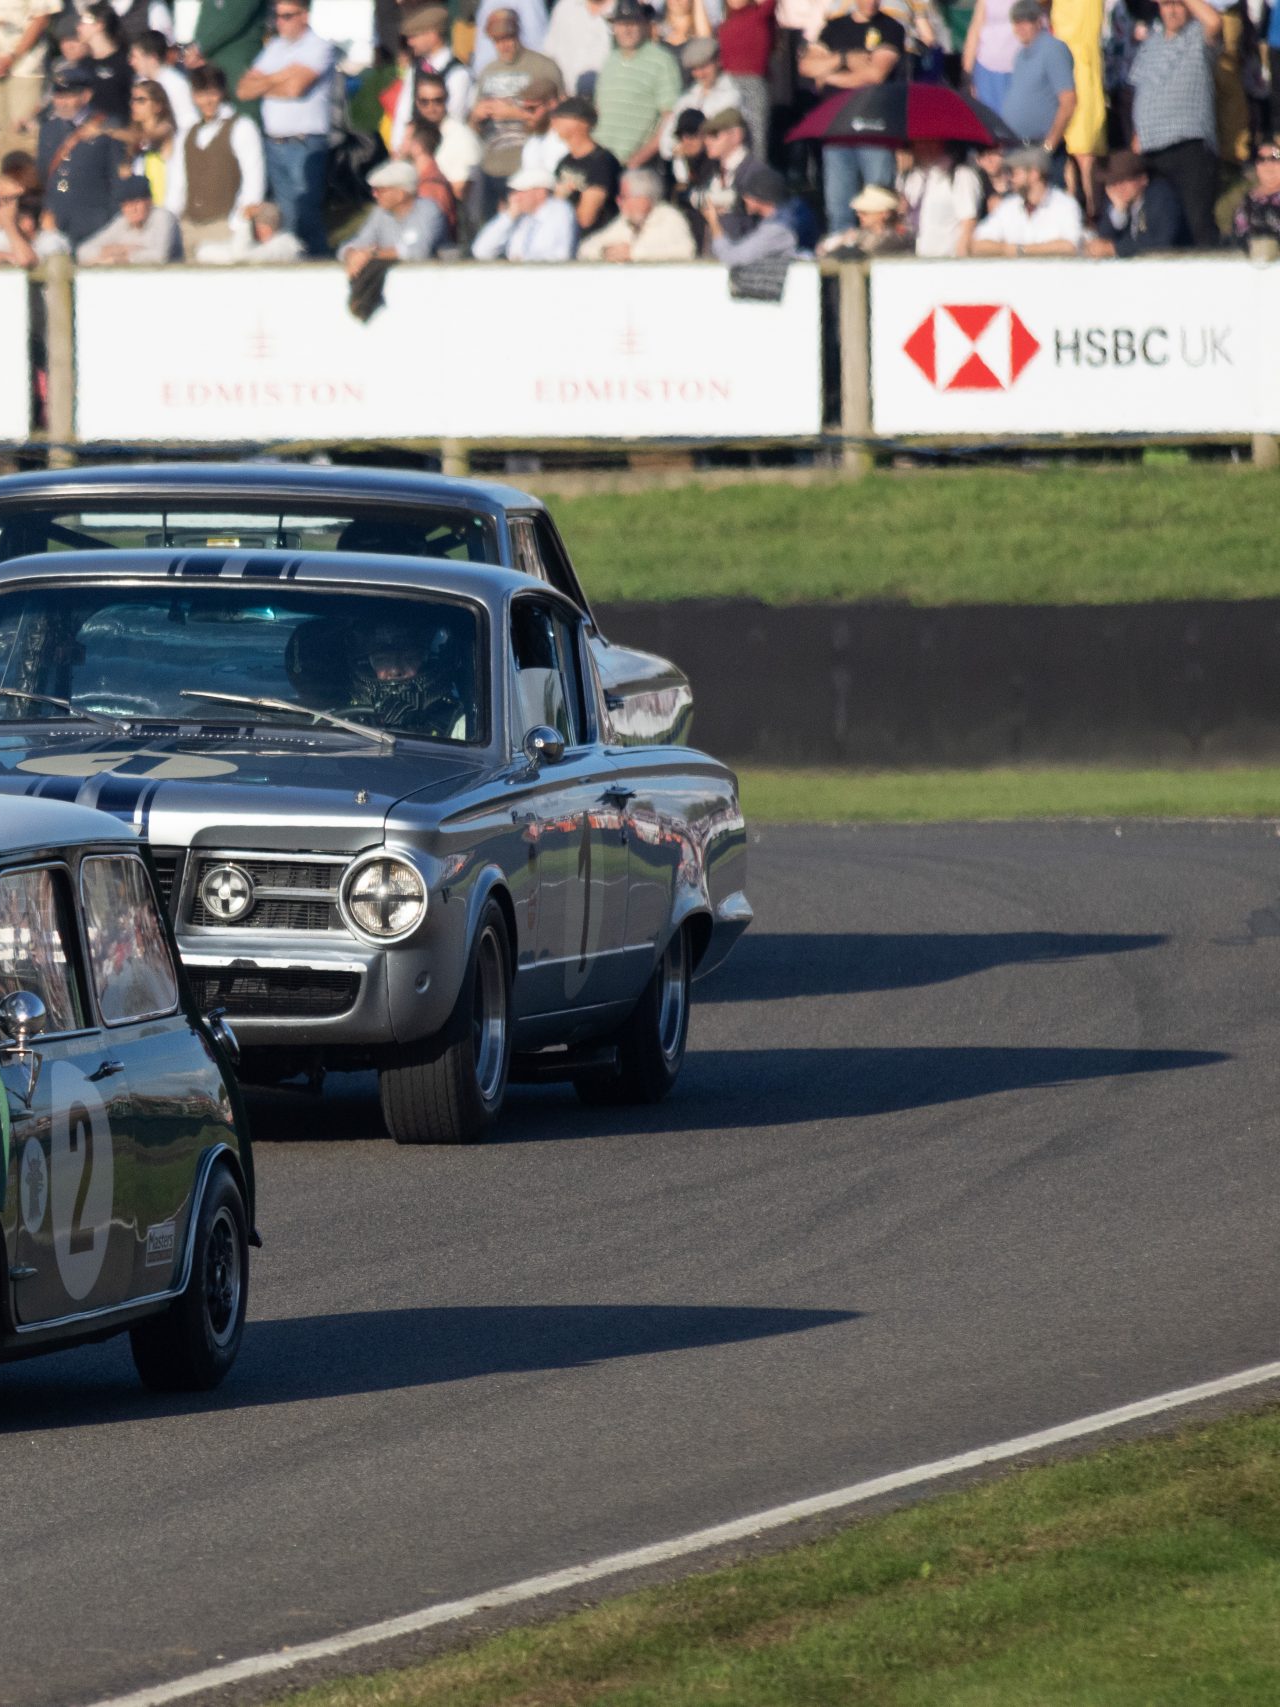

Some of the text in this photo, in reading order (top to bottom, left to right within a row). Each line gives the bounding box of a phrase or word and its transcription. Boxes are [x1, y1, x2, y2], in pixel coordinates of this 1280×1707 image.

[1053, 325, 1235, 368] HSBC UK
[162, 381, 364, 406] EDMISTON
[535, 379, 731, 404] EDMISTON
[69, 1102, 94, 1255] 2
[149, 1231, 174, 1250] Masters
